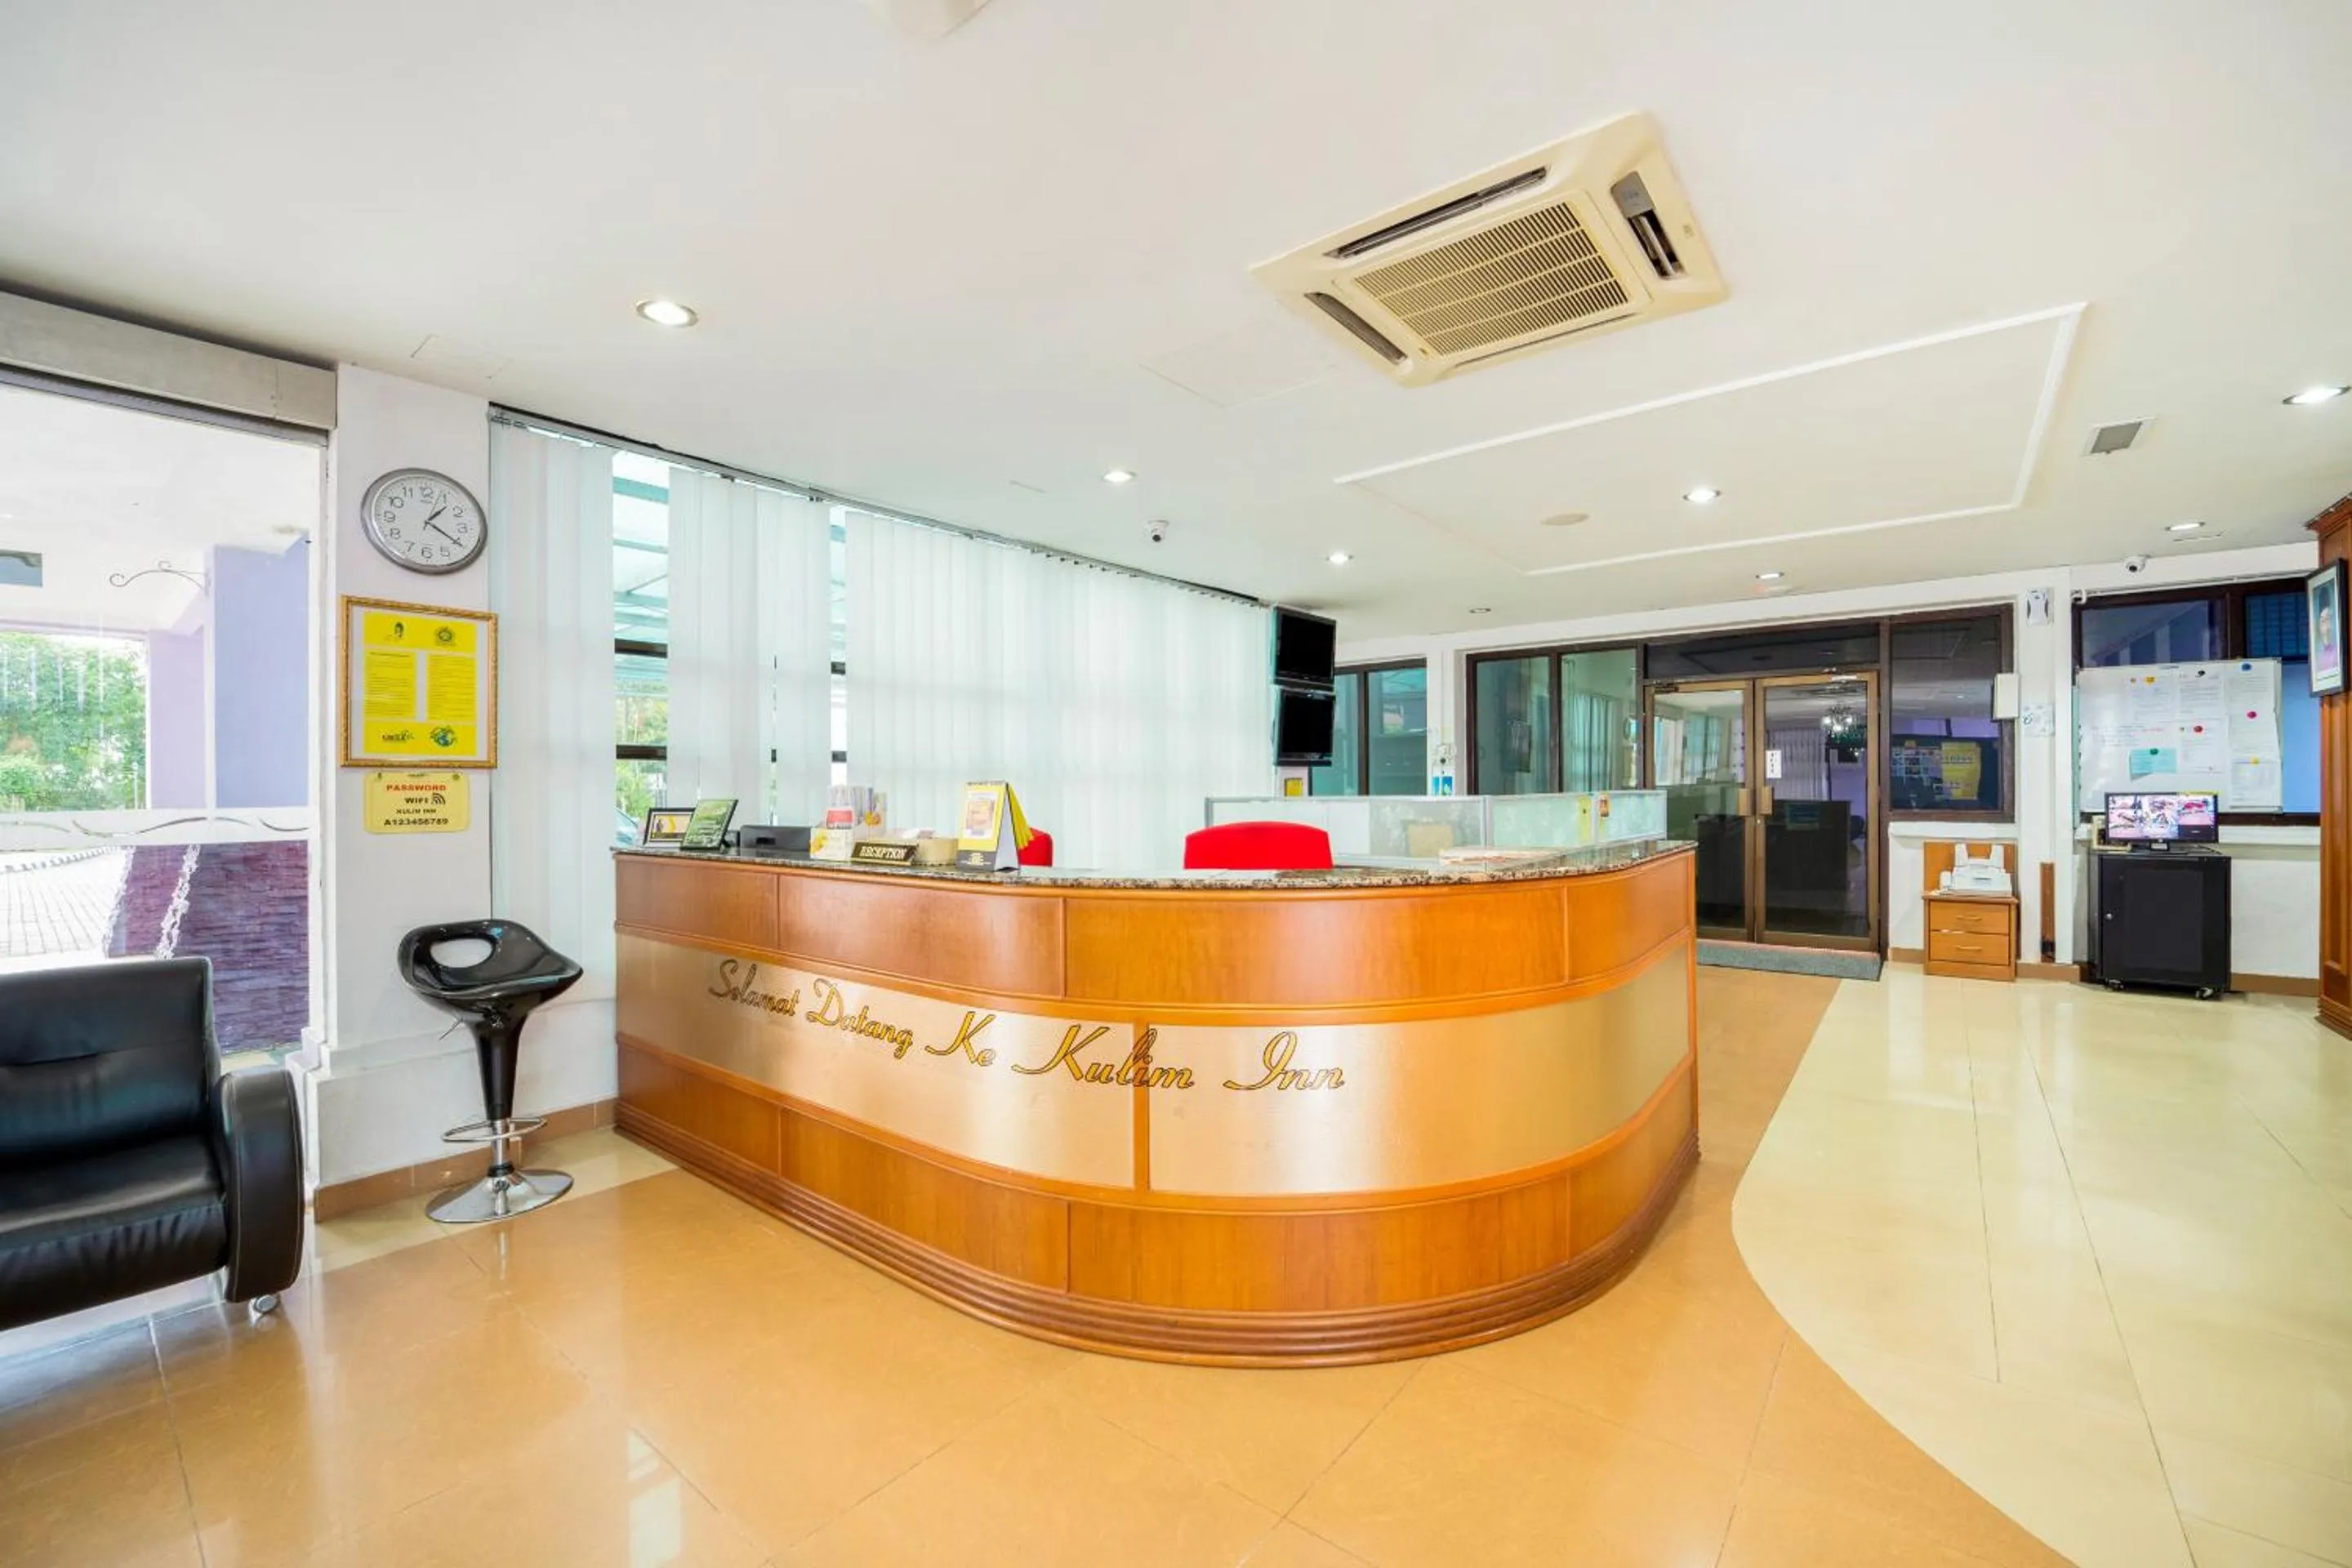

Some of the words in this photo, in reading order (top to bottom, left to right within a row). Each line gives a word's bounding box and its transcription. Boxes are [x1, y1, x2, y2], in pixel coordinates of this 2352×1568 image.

[402, 487, 413, 498] 11
[421, 486, 434, 498] 12
[390, 497, 404, 508] 10
[384, 510, 396, 523] 9
[453, 506, 463, 517] 2
[457, 523, 468, 533] 3
[390, 528, 401, 540] 8
[404, 541, 415, 552] 7
[441, 546, 451, 557] 5
[421, 546, 434, 559] 6
[384, 818, 448, 826] A123456789
[860, 845, 906, 858] RECEPTION
[805, 978, 913, 1059] Datang
[925, 1010, 998, 1067] Ke
[1011, 1024, 1195, 1089] Kulim
[1223, 1031, 1345, 1090] Inn
